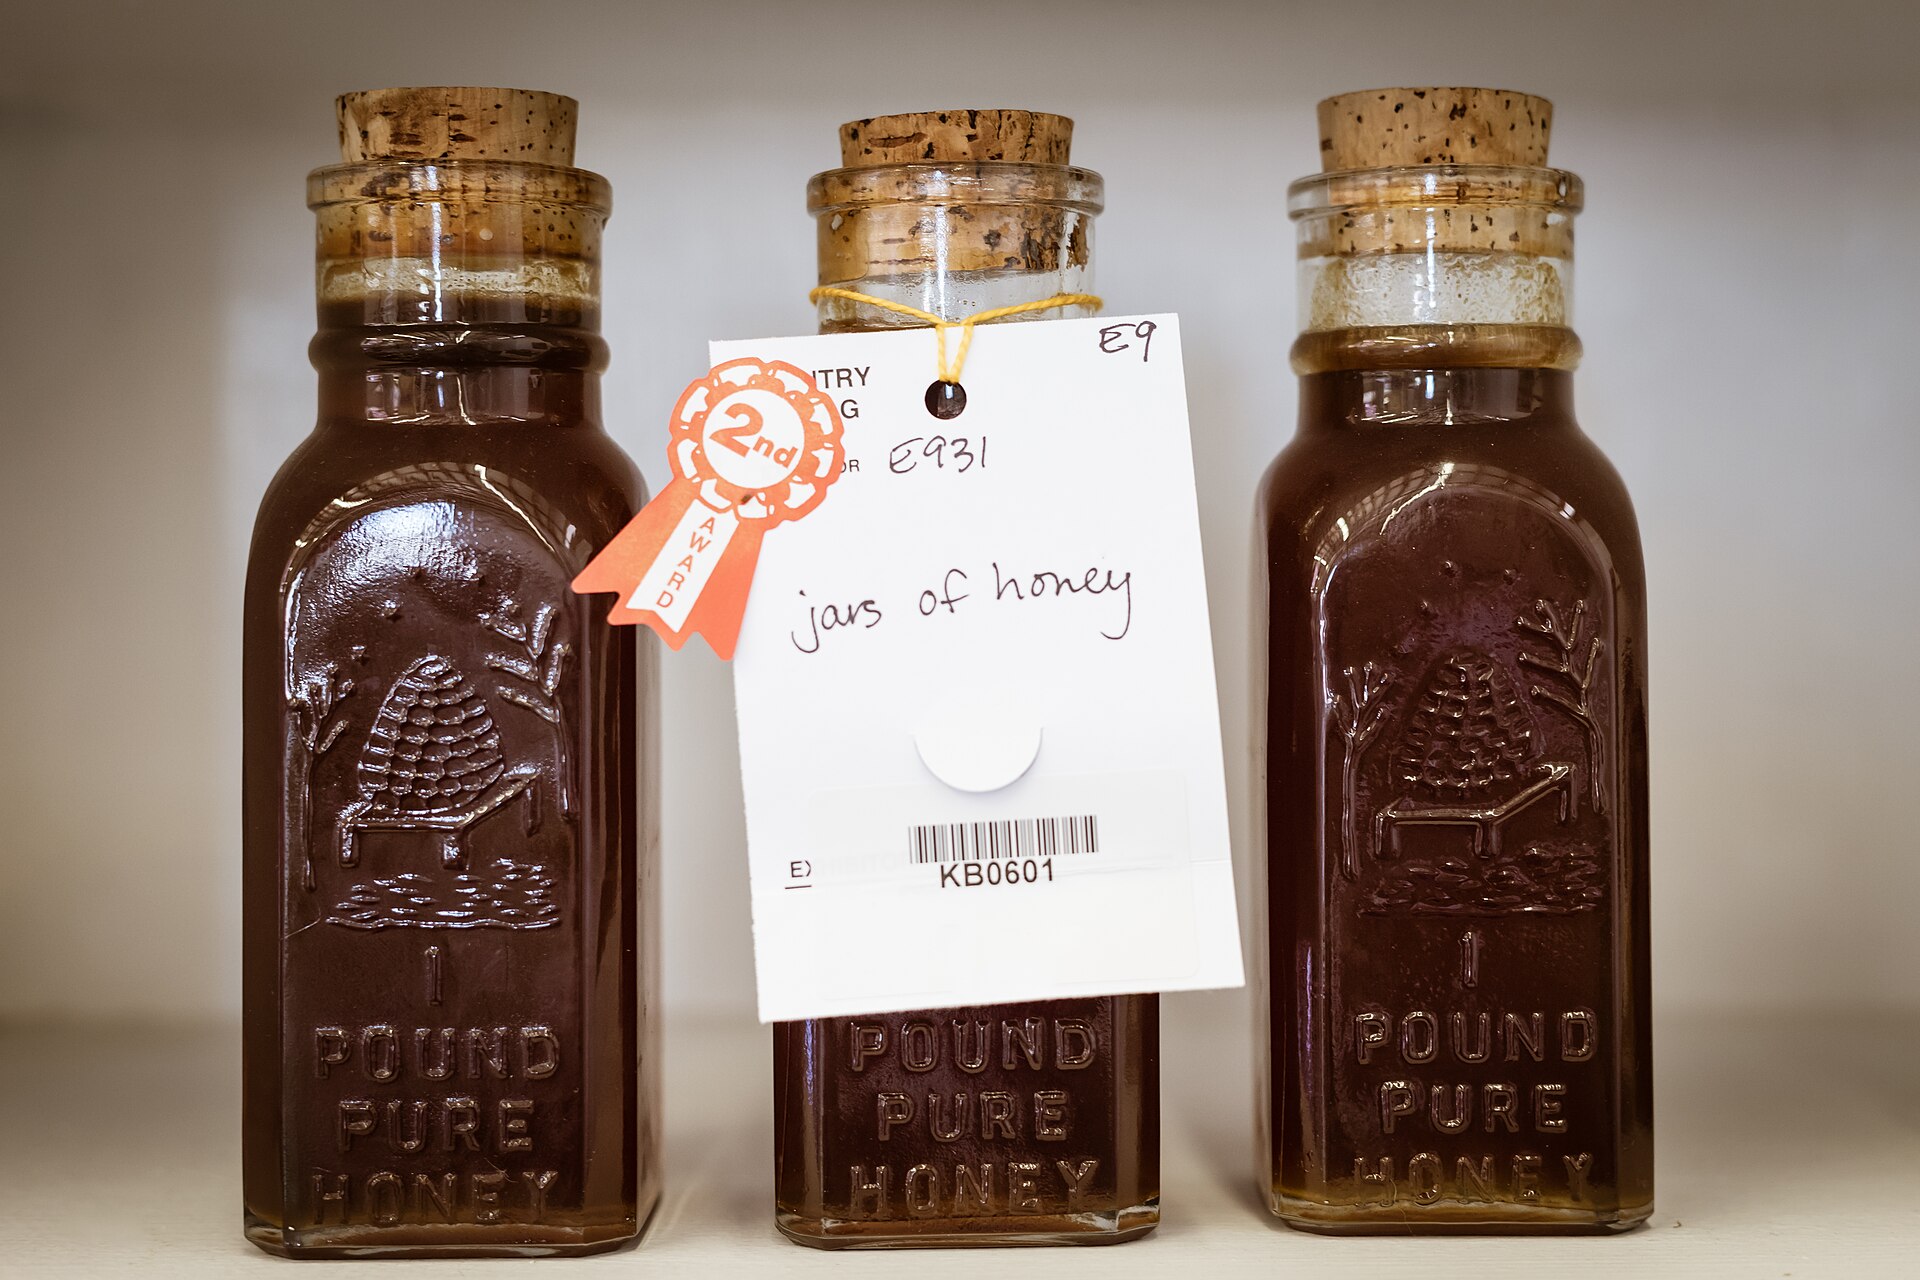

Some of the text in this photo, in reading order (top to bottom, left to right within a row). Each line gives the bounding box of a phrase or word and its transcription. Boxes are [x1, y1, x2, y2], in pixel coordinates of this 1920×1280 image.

[1099, 320, 1157, 362] E9
[709, 402, 799, 469] 2nd
[889, 435, 987, 474] E931
[656, 516, 712, 608] AWARD
[791, 562, 1132, 653] jars of honey
[940, 858, 1054, 888] KB0601
[314, 1022, 560, 1083] POUND
[850, 1016, 1096, 1074] POUND
[1354, 1010, 1598, 1065] POUND
[337, 1097, 535, 1153] PURE
[877, 1090, 1070, 1142] PURE
[1379, 1080, 1569, 1134] PURE
[311, 1171, 559, 1225] HONEY
[850, 1159, 1097, 1220] HONEY
[1353, 1152, 1594, 1208] HONEY
